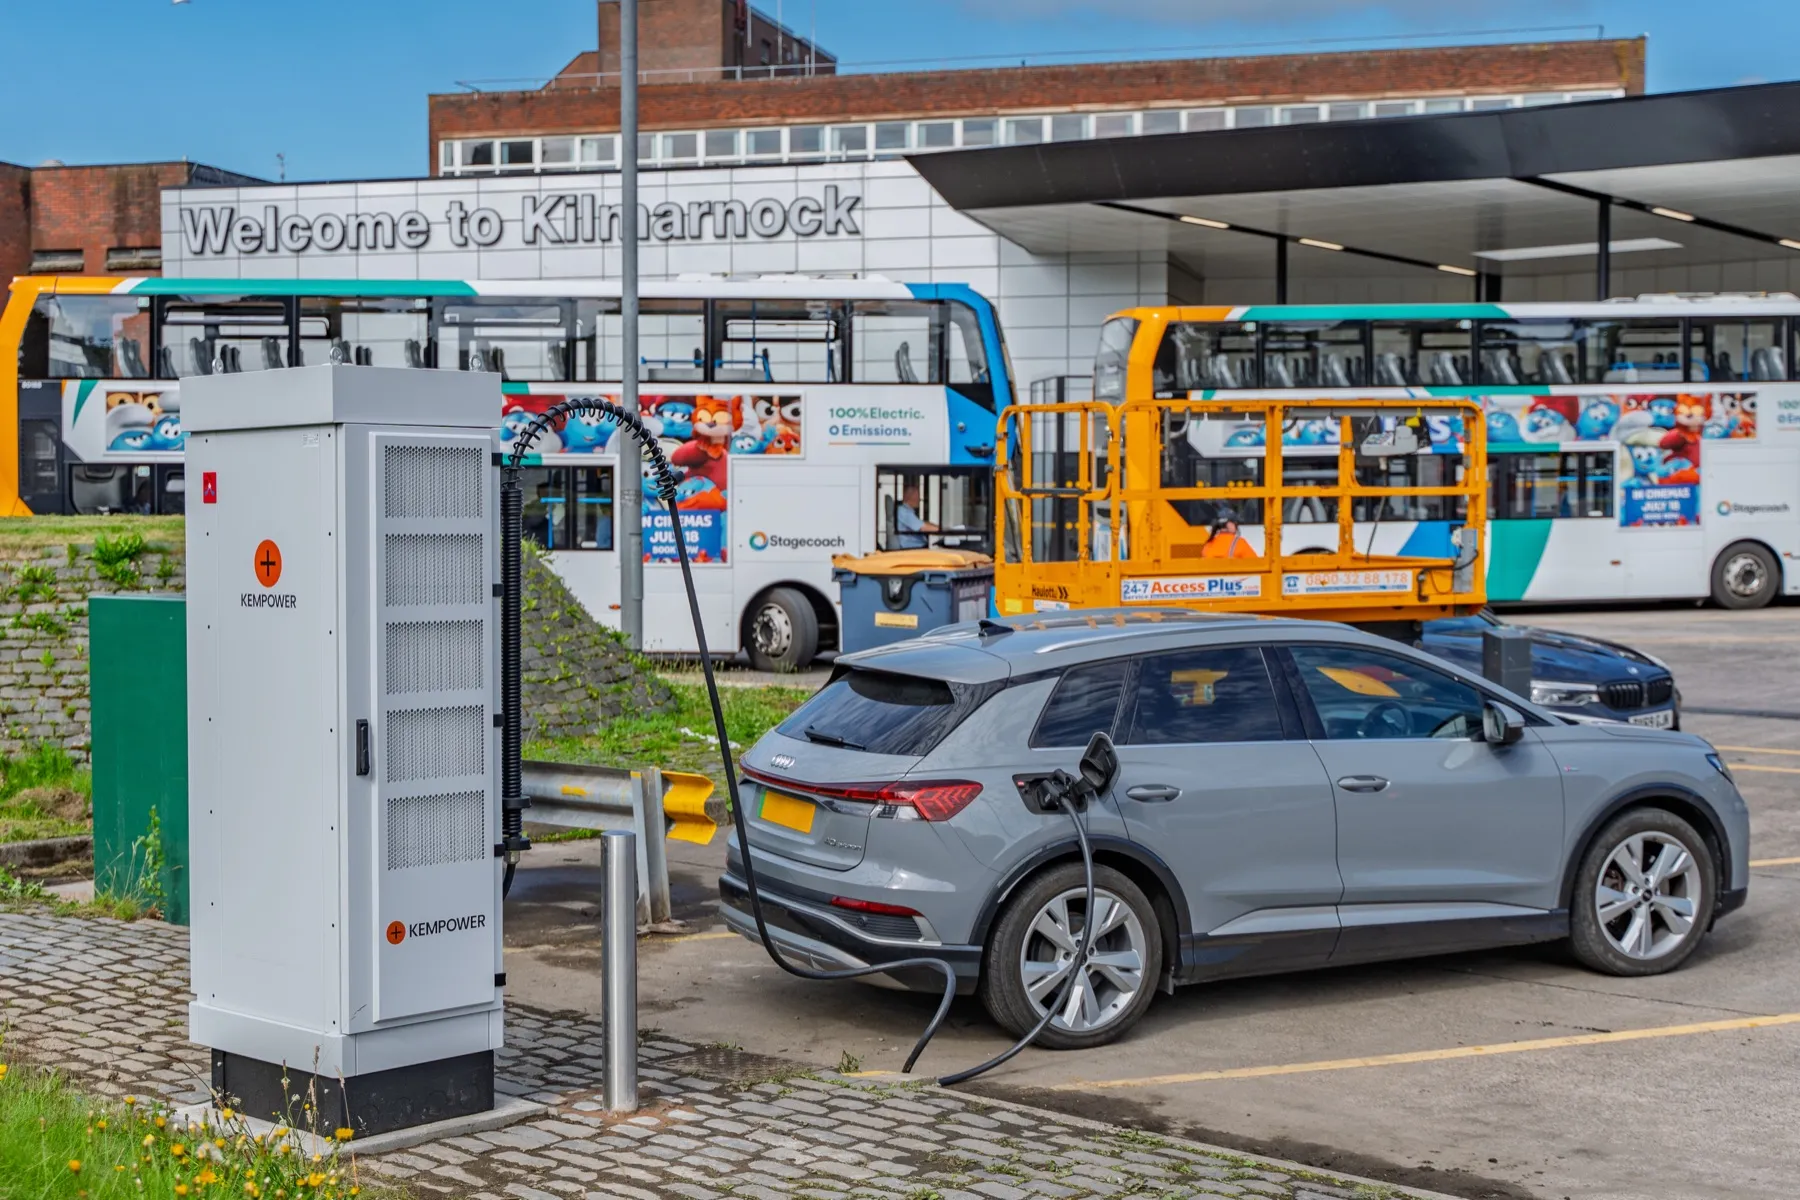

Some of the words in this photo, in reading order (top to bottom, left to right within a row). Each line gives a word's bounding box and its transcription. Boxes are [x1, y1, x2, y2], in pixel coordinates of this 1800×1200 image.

[180, 205, 431, 255] Welcome
[445, 200, 504, 247] to
[522, 184, 862, 245] Kilmarnock
[870, 406, 925, 419] Electric.
[841, 424, 912, 437] Emissions.
[642, 515, 652, 528] N
[649, 530, 676, 543] JUL
[684, 530, 700, 543] 18
[769, 534, 846, 550] Stagecoach
[1151, 580, 1206, 594] Access
[1207, 577, 1243, 592] Plus
[240, 593, 297, 609] KEMPOWER
[409, 914, 486, 938] KEMPOWER
